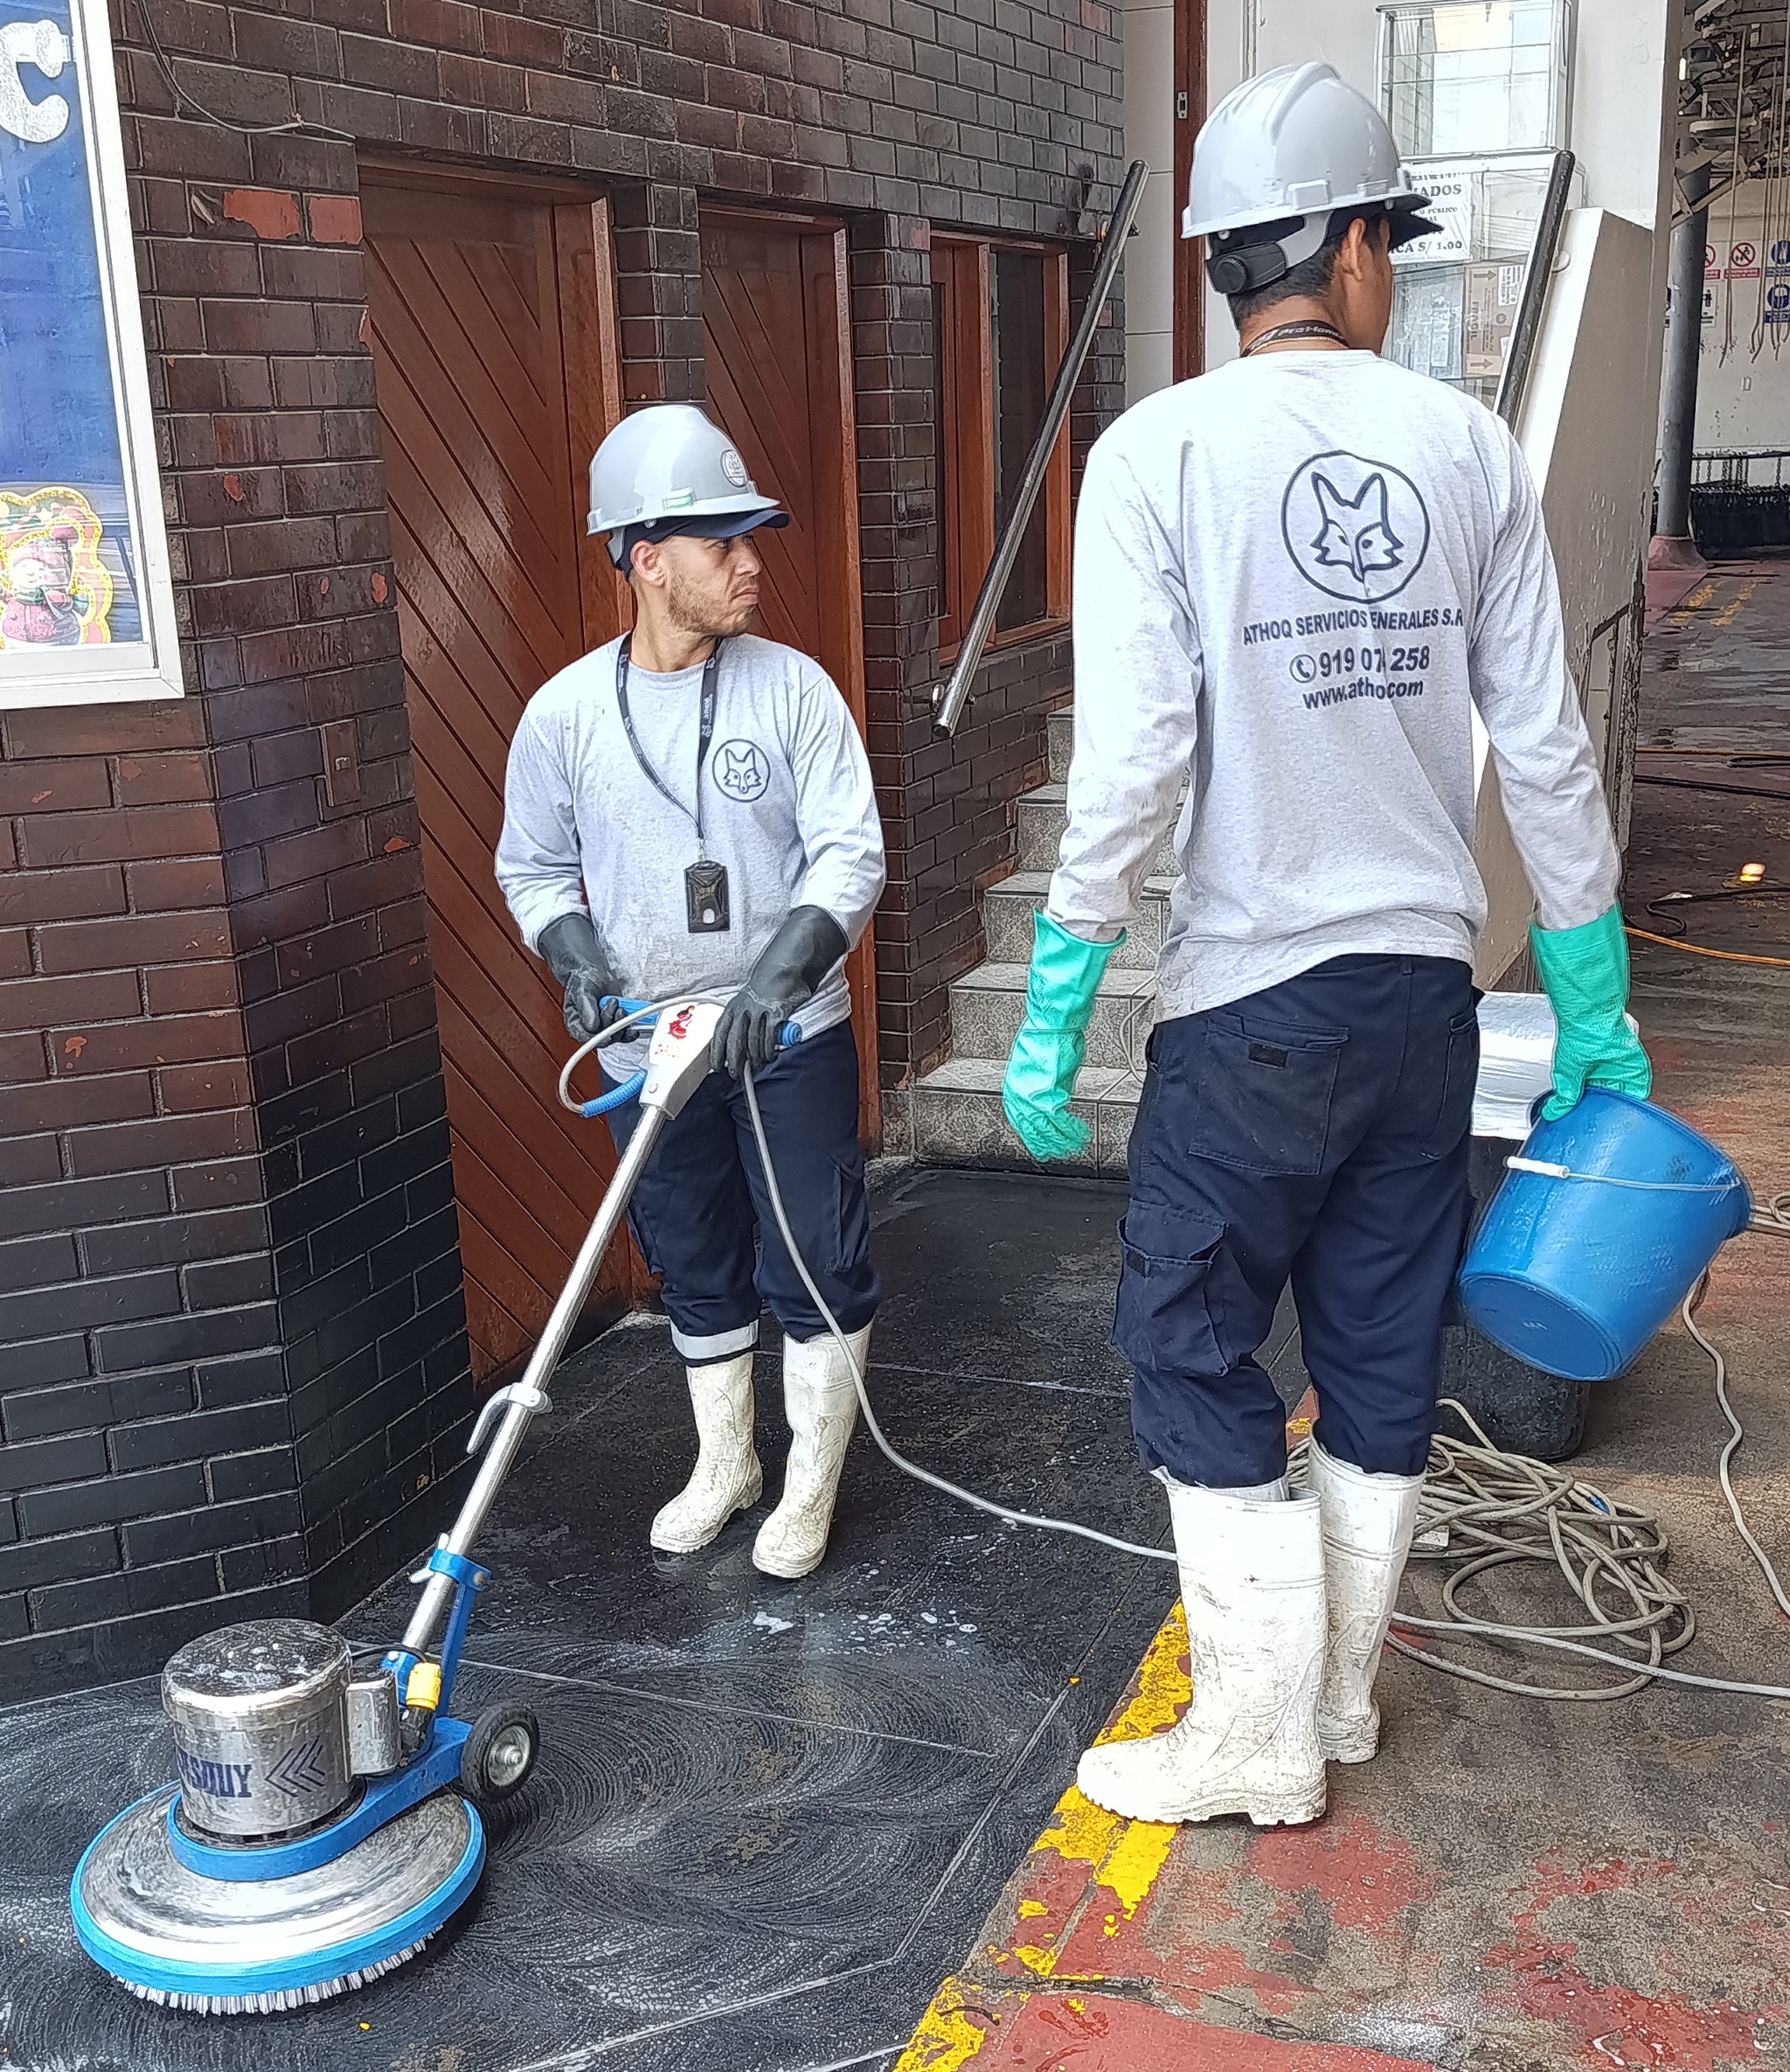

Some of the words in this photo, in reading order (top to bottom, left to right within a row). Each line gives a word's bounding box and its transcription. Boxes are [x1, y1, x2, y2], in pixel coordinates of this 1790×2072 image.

[1437, 240, 1463, 250] 1.00
[1243, 618, 1293, 646] ATHOQ
[1295, 608, 1368, 636] SERVICIOS
[1370, 608, 1439, 631] ENERALES
[1319, 646, 1355, 677] 919
[1361, 646, 1386, 673] 07
[1390, 645, 1430, 671] 258
